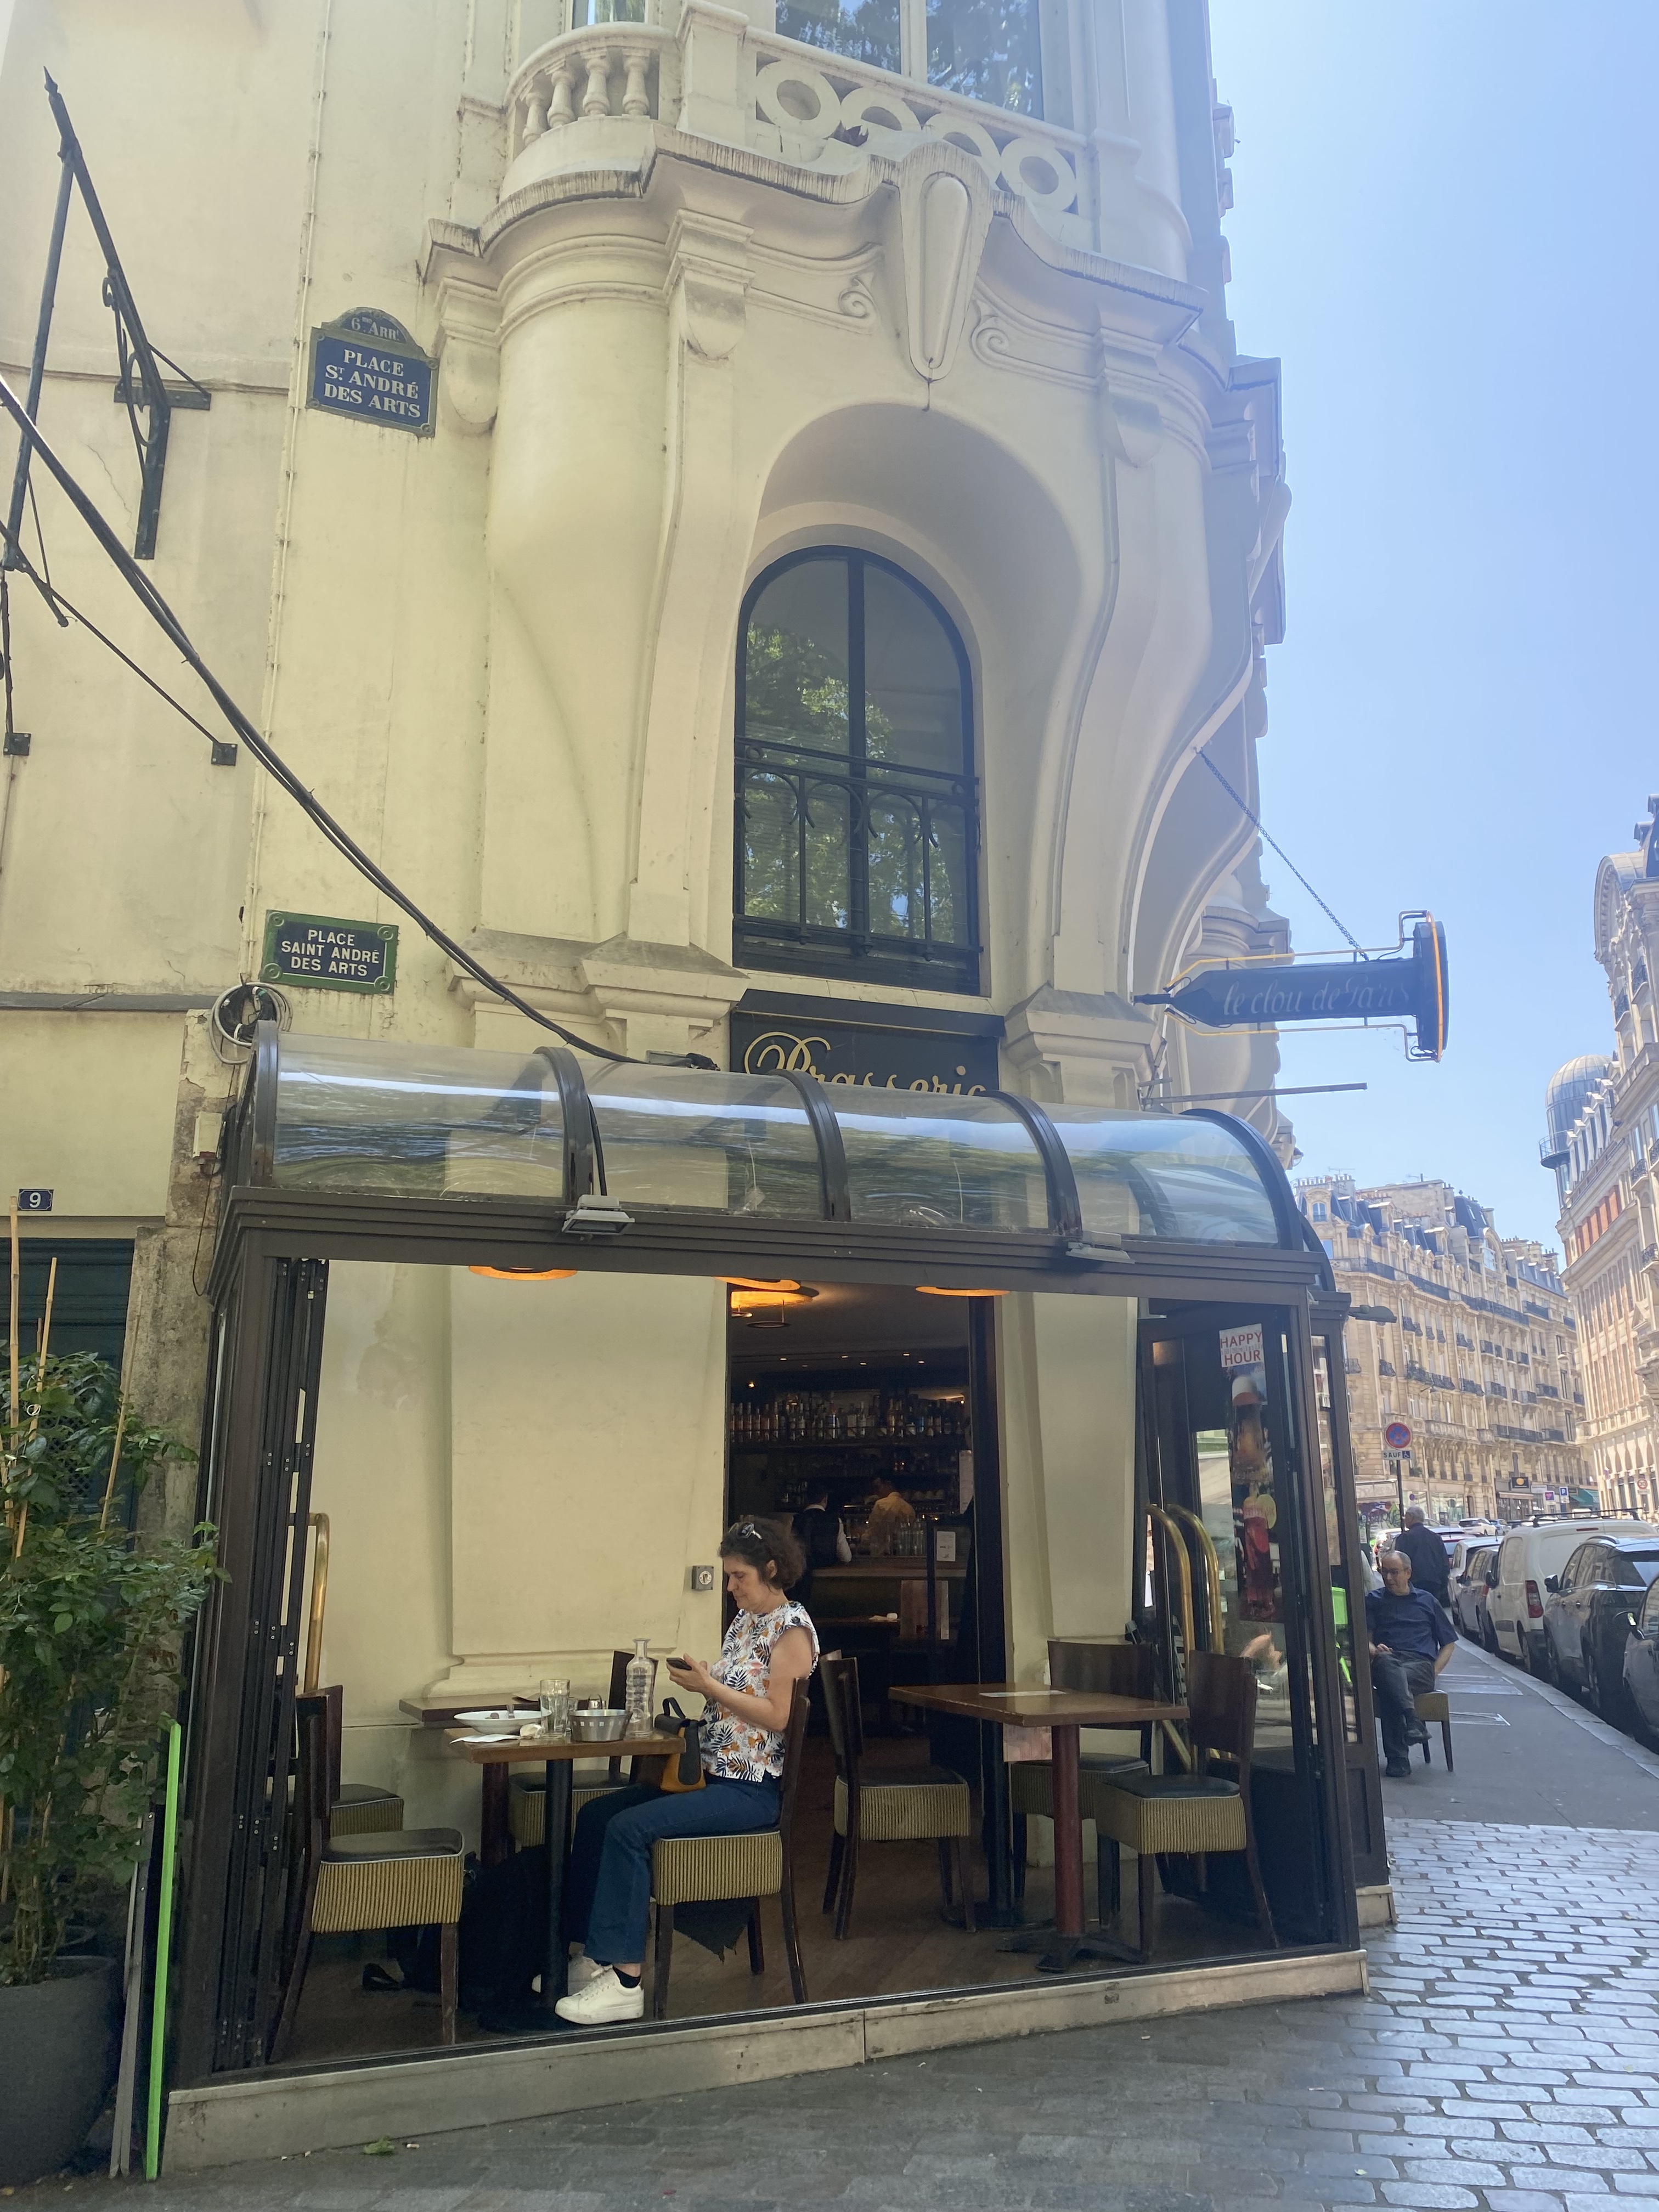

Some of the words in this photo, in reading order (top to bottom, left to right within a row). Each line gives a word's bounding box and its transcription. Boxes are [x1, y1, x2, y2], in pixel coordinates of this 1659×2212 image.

[343, 349, 404, 377] PLACE
[348, 371, 419, 399] ANDRÉ
[324, 383, 363, 404] DES
[368, 394, 421, 418] ARTS
[308, 929, 356, 946] PLACE
[281, 941, 325, 957] SAINT
[331, 947, 380, 964] ANDRÉ
[291, 957, 321, 971] DES
[329, 961, 368, 977] ARTS
[1251, 977, 1302, 1015] clou
[1312, 981, 1341, 1011] de
[29, 1192, 41, 1208] 9
[1220, 1331, 1262, 1348] HAPPY
[1224, 1350, 1261, 1365] HOUR
